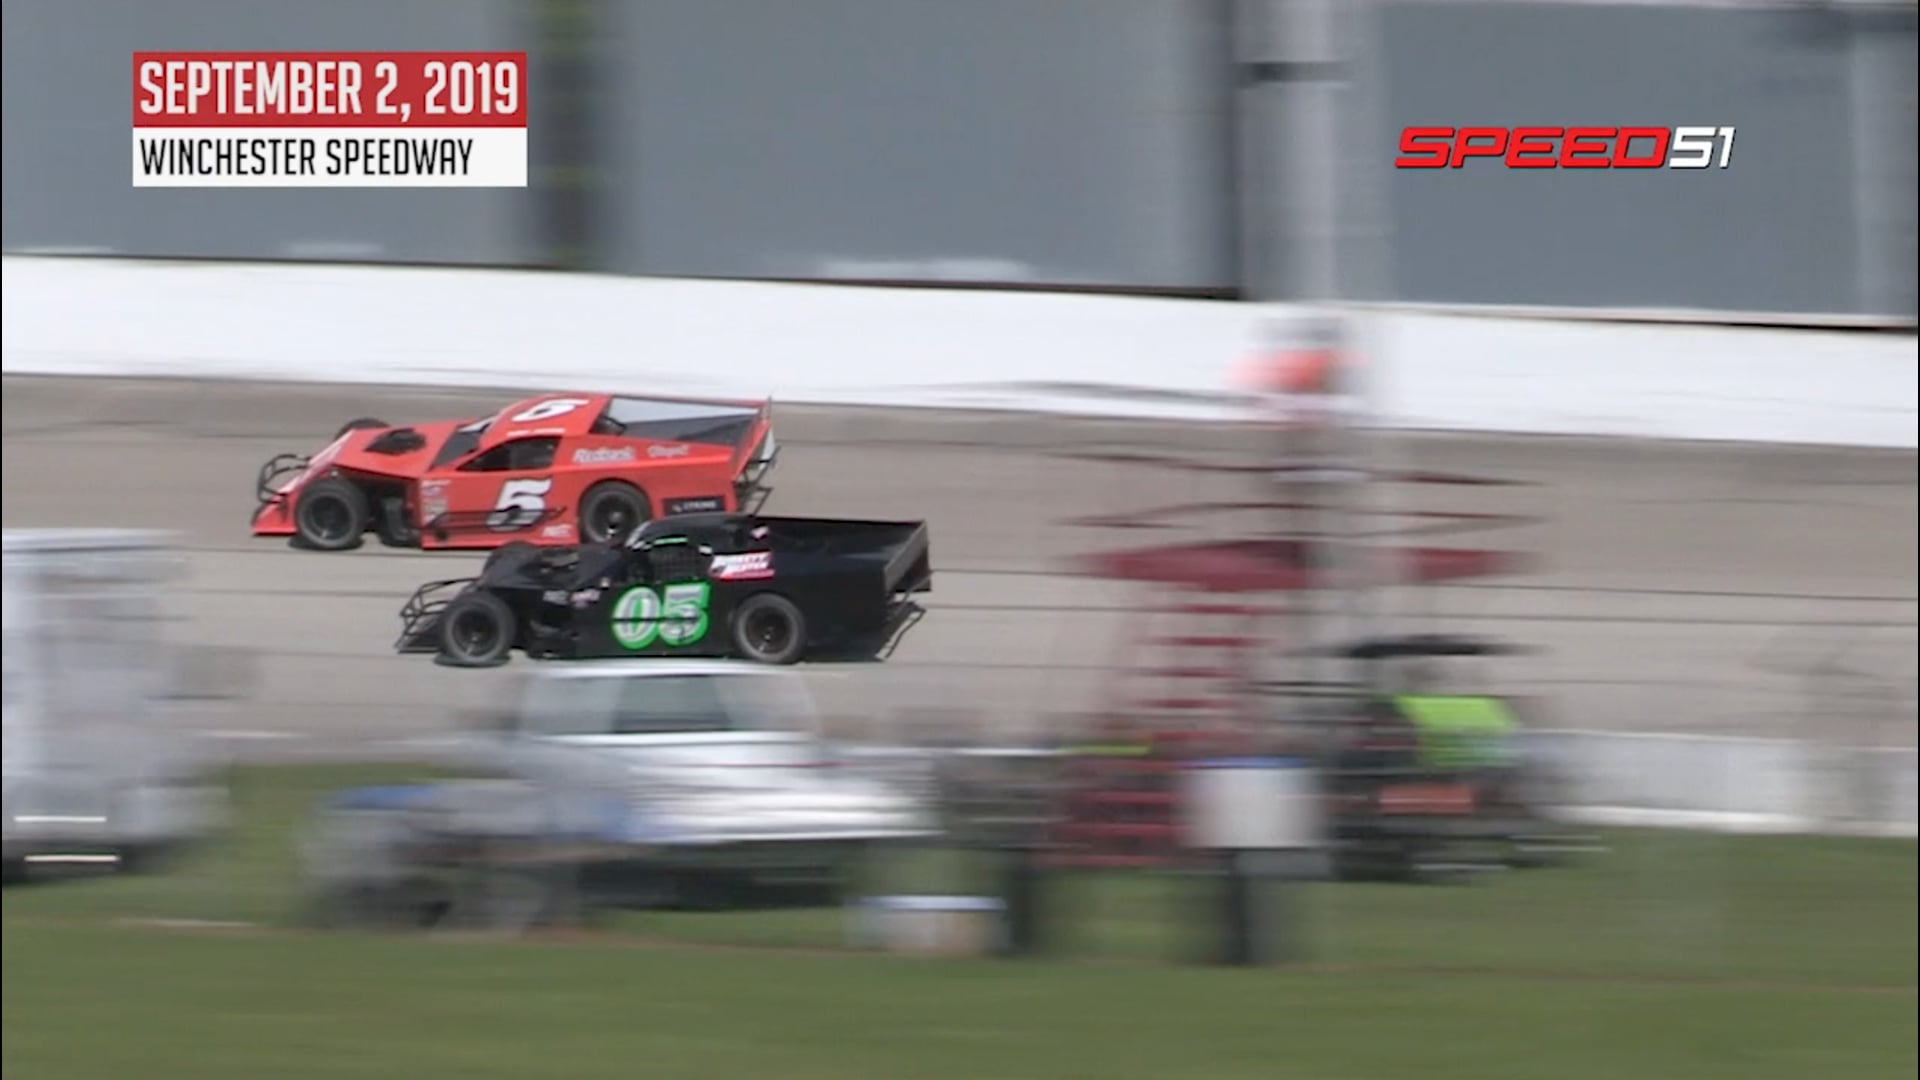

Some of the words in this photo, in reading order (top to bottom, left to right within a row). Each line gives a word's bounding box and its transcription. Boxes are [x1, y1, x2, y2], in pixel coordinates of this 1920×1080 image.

[511, 399, 590, 422] 5
[485, 477, 553, 533] 5
[612, 582, 711, 650] 05
